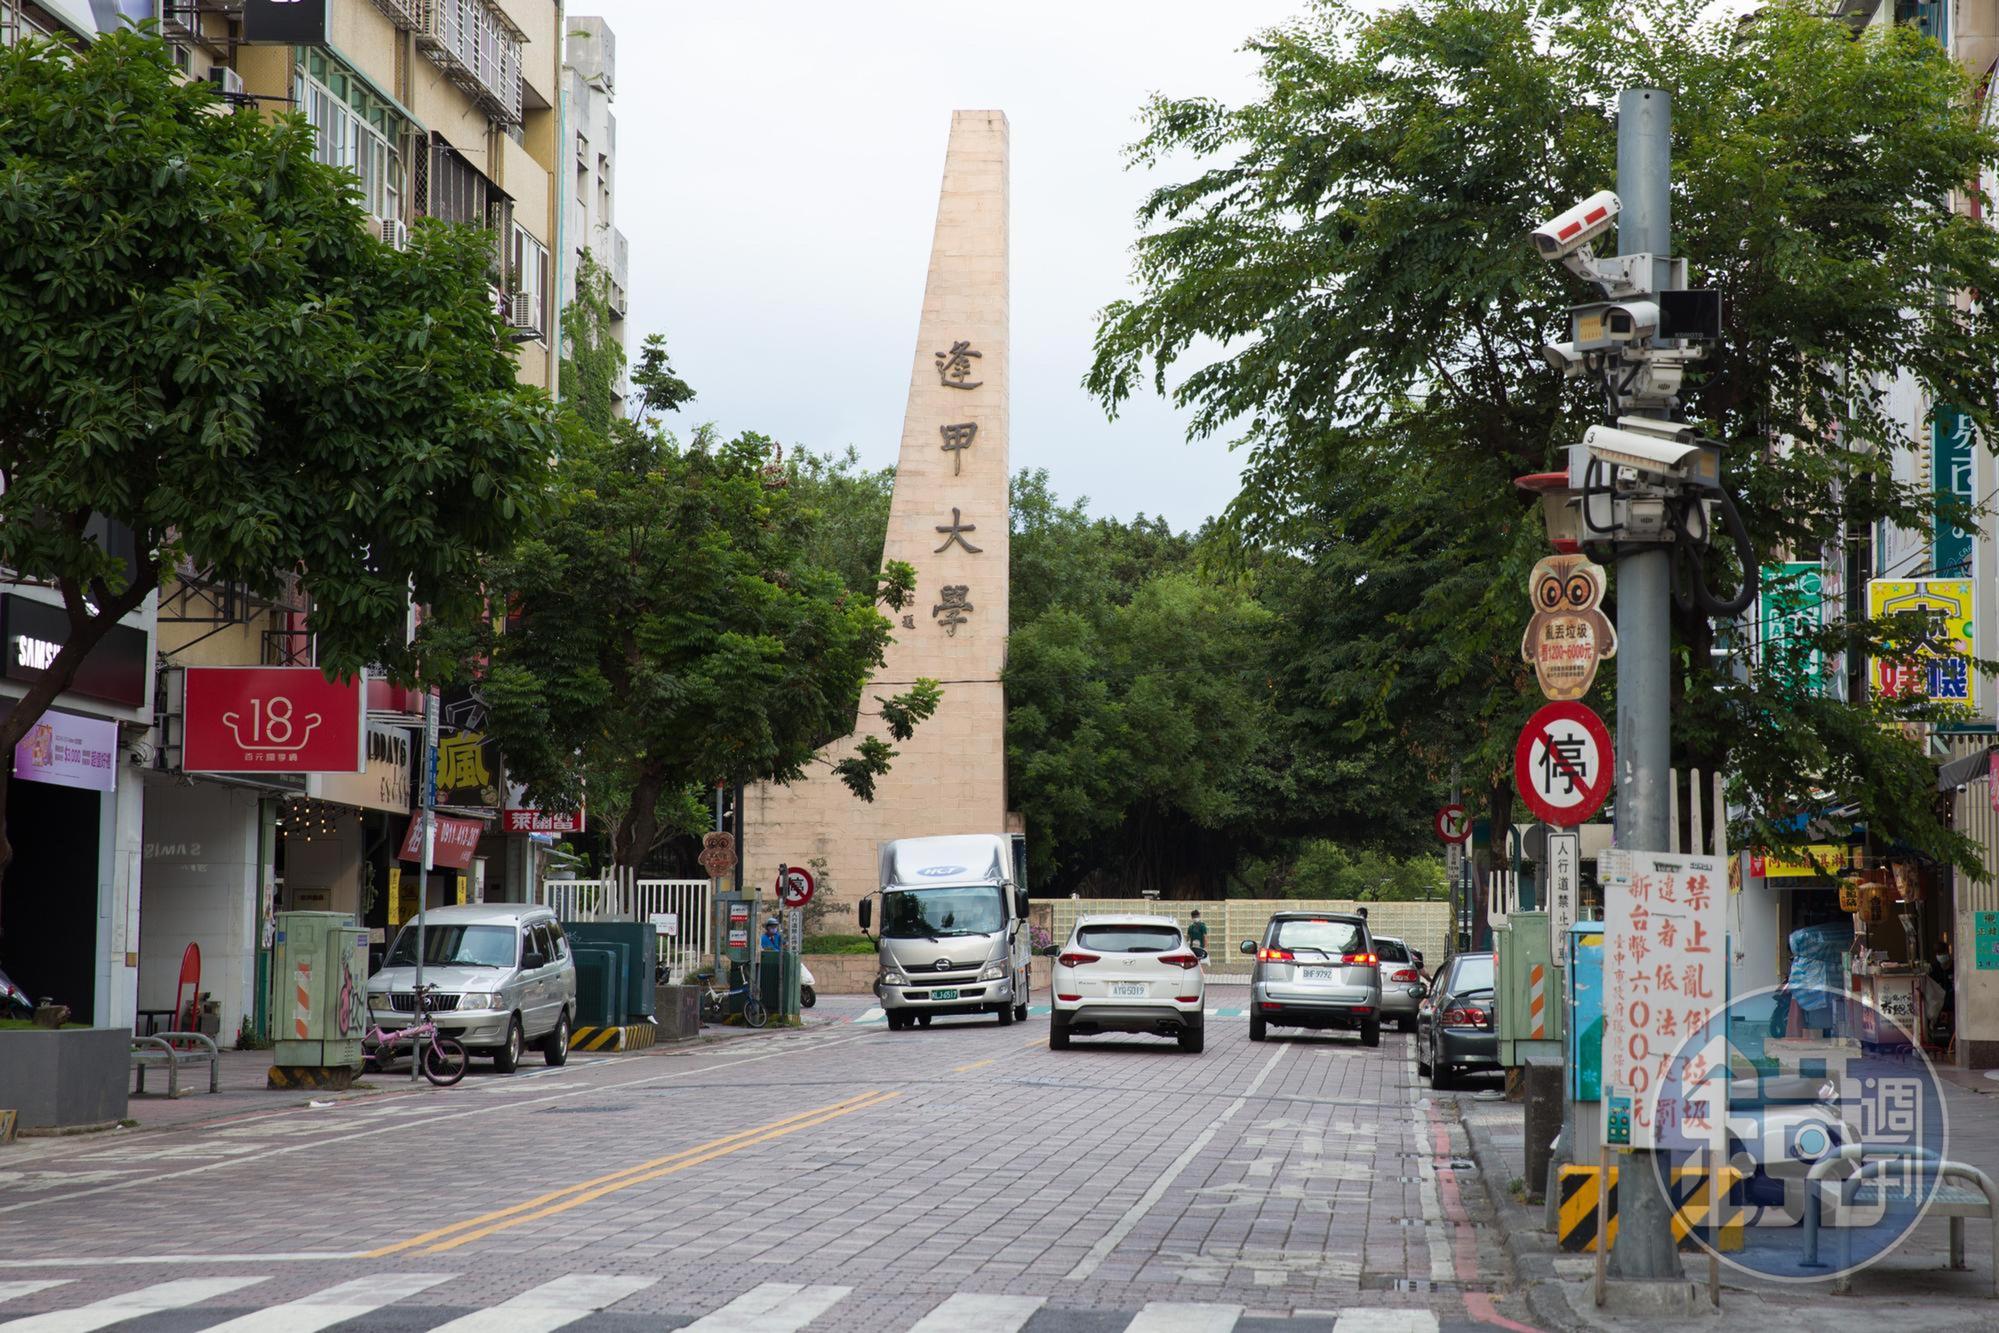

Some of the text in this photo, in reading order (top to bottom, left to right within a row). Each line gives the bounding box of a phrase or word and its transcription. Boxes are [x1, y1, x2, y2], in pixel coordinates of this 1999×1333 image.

[1587, 432, 1596, 444] 3
[933, 341, 983, 637] 逢甲大學
[1545, 624, 1587, 640] 亂丟垃圾
[251, 696, 293, 743] 18
[1538, 732, 1588, 795] 停
[1557, 841, 1570, 962] 人行道禁止停車
[1682, 873, 1713, 1131] 禁止亂倒垃圾
